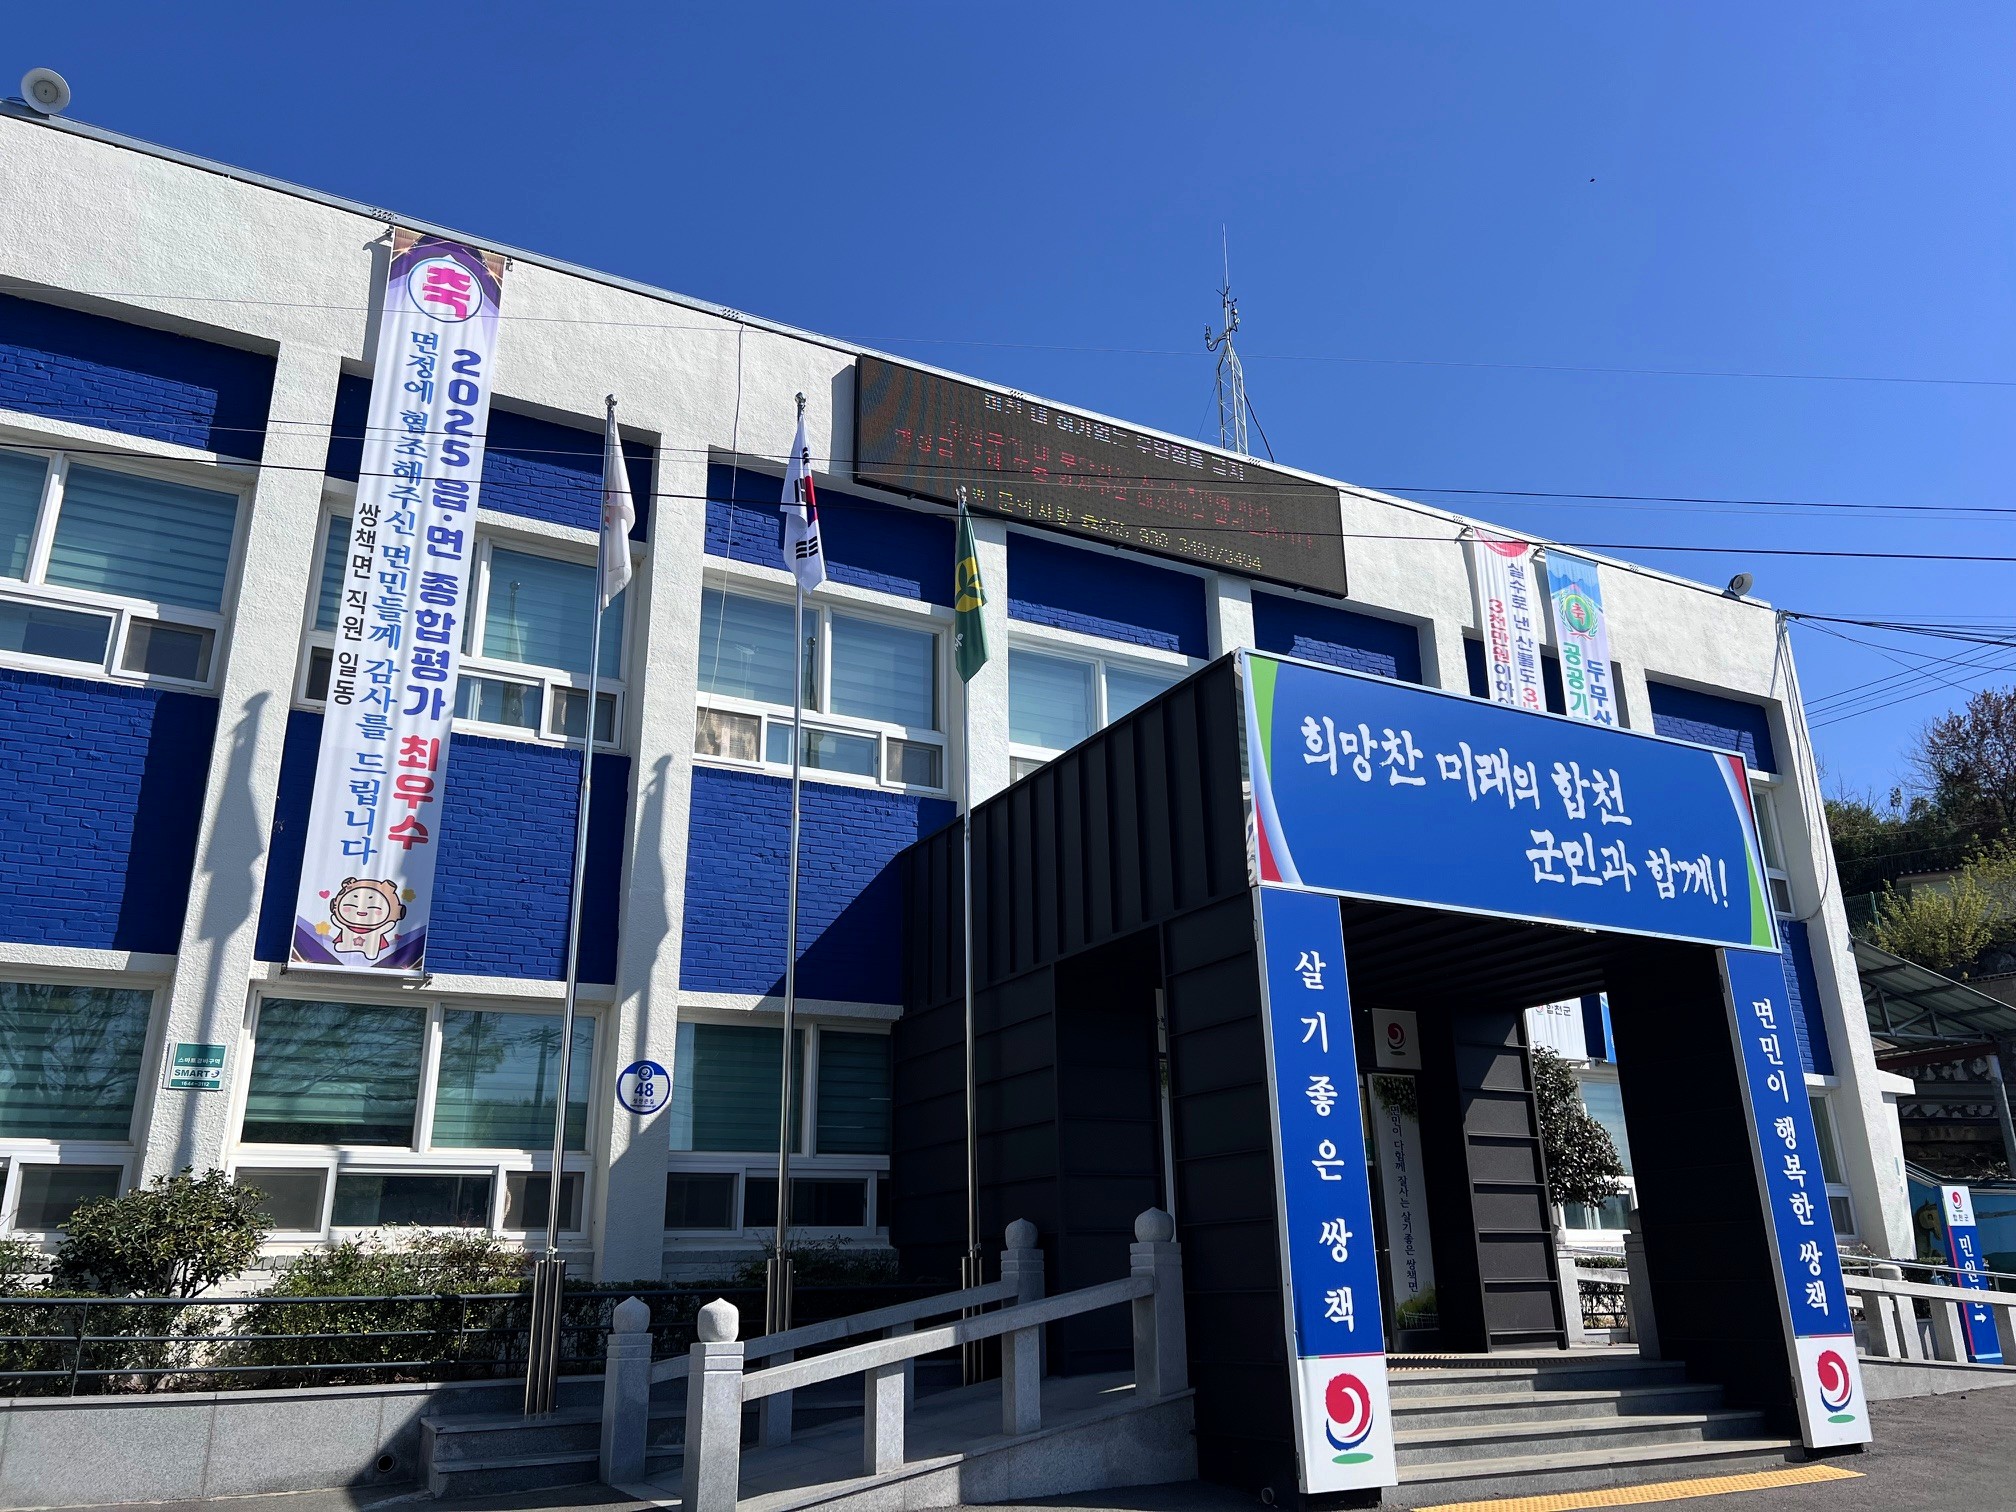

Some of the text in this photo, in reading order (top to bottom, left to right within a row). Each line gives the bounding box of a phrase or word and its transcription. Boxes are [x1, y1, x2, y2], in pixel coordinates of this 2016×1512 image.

[421, 265, 471, 319] 축
[333, 502, 381, 706] 쌍책면 직원 일동
[340, 331, 439, 866] 면정에 협조해주신 면민들께 감사를 드립니다
[387, 348, 482, 850] 2025 읍·면 종합평가 최우수
[1507, 563, 1529, 611] 실수로
[1513, 614, 1530, 632] 낸
[1515, 635, 1537, 685] 산불도
[1301, 715, 1633, 826] 희망찬 미래의 합천
[1525, 829, 1730, 908] 군민과 함께!
[174, 1068, 211, 1078] SMART
[634, 1082, 654, 1097] 48
[1752, 997, 1830, 1317] 면민이 행복한 쌍책
[1319, 1218, 1355, 1333] 쌍책
[1406, 1259, 1419, 1293] 쌍책면
